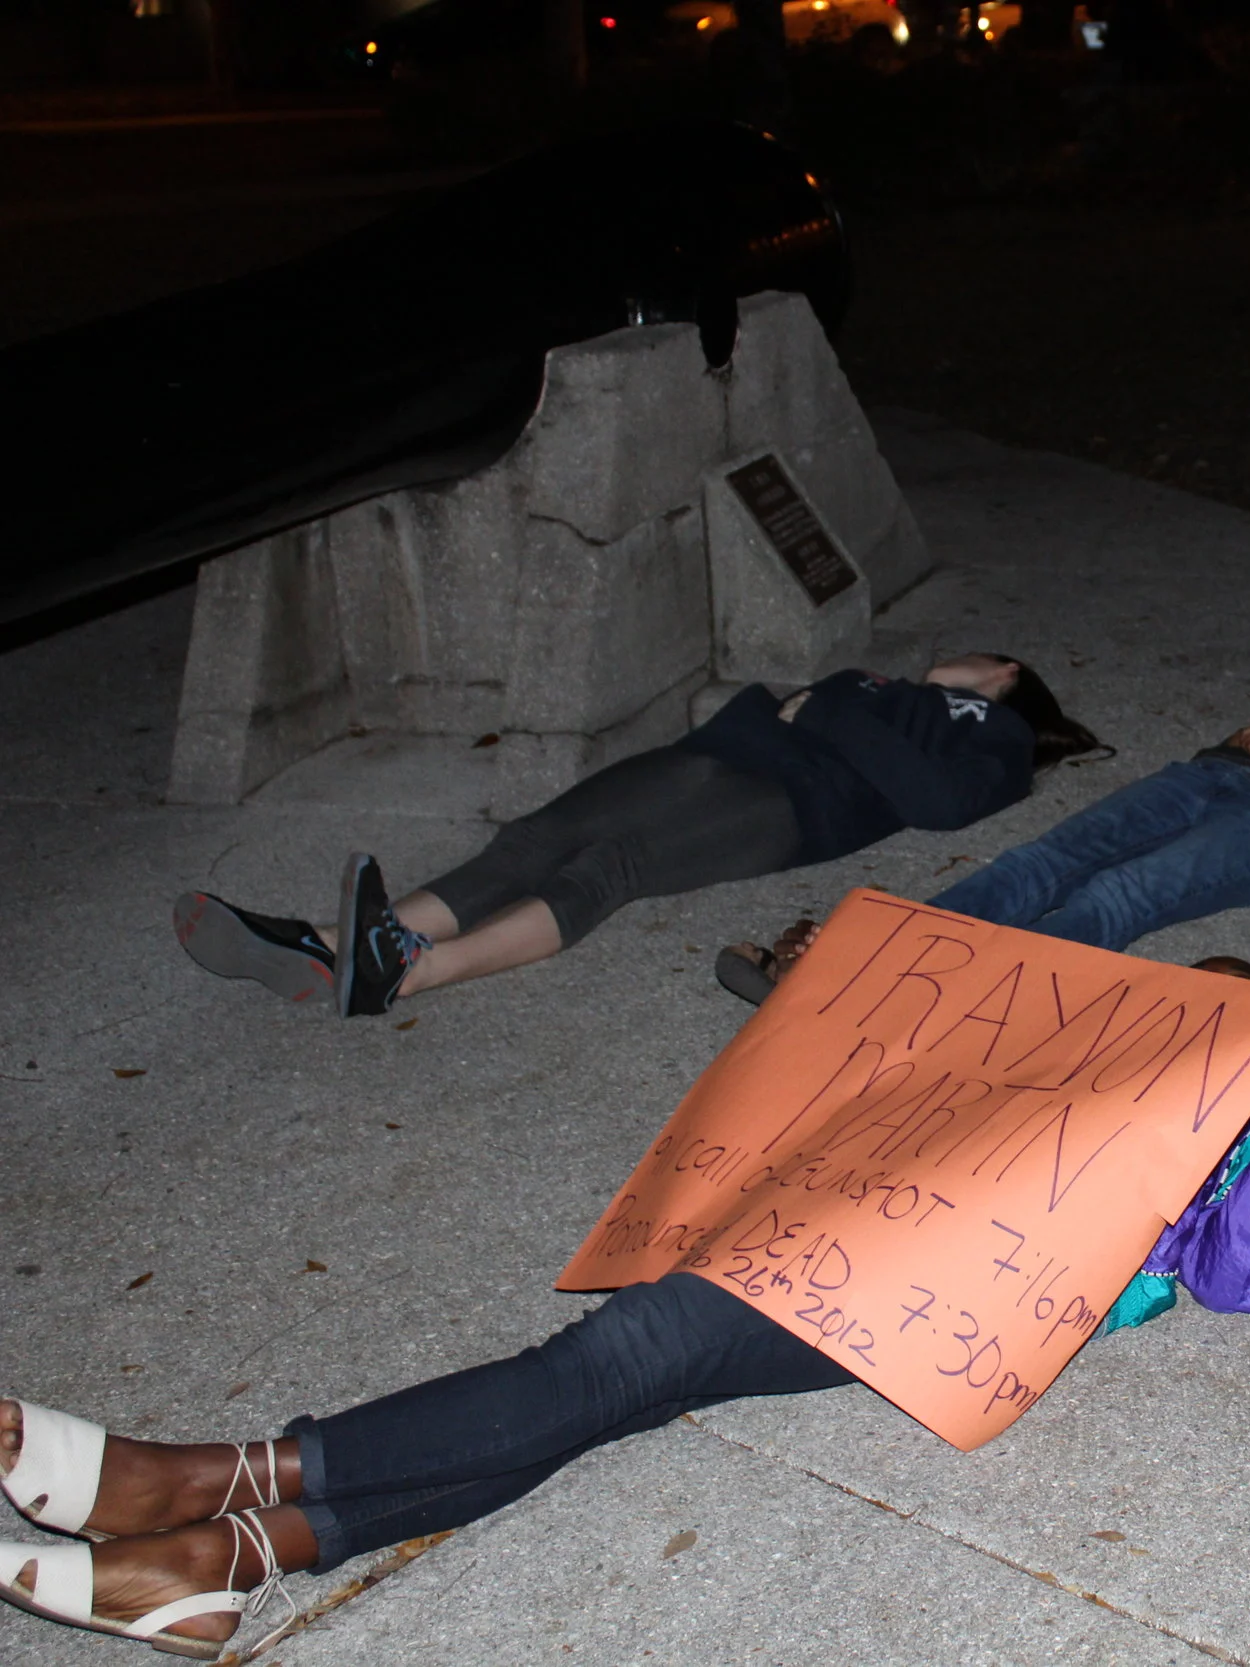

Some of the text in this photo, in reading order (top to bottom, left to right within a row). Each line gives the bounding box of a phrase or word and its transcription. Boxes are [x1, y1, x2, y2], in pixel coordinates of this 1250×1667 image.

[762, 1036, 1132, 1213] MARTIN
[779, 1156, 956, 1227] GUNSHOT
[731, 1209, 852, 1290] DEAD
[723, 1255, 794, 1297] 26th
[795, 1292, 877, 1367] 2012
